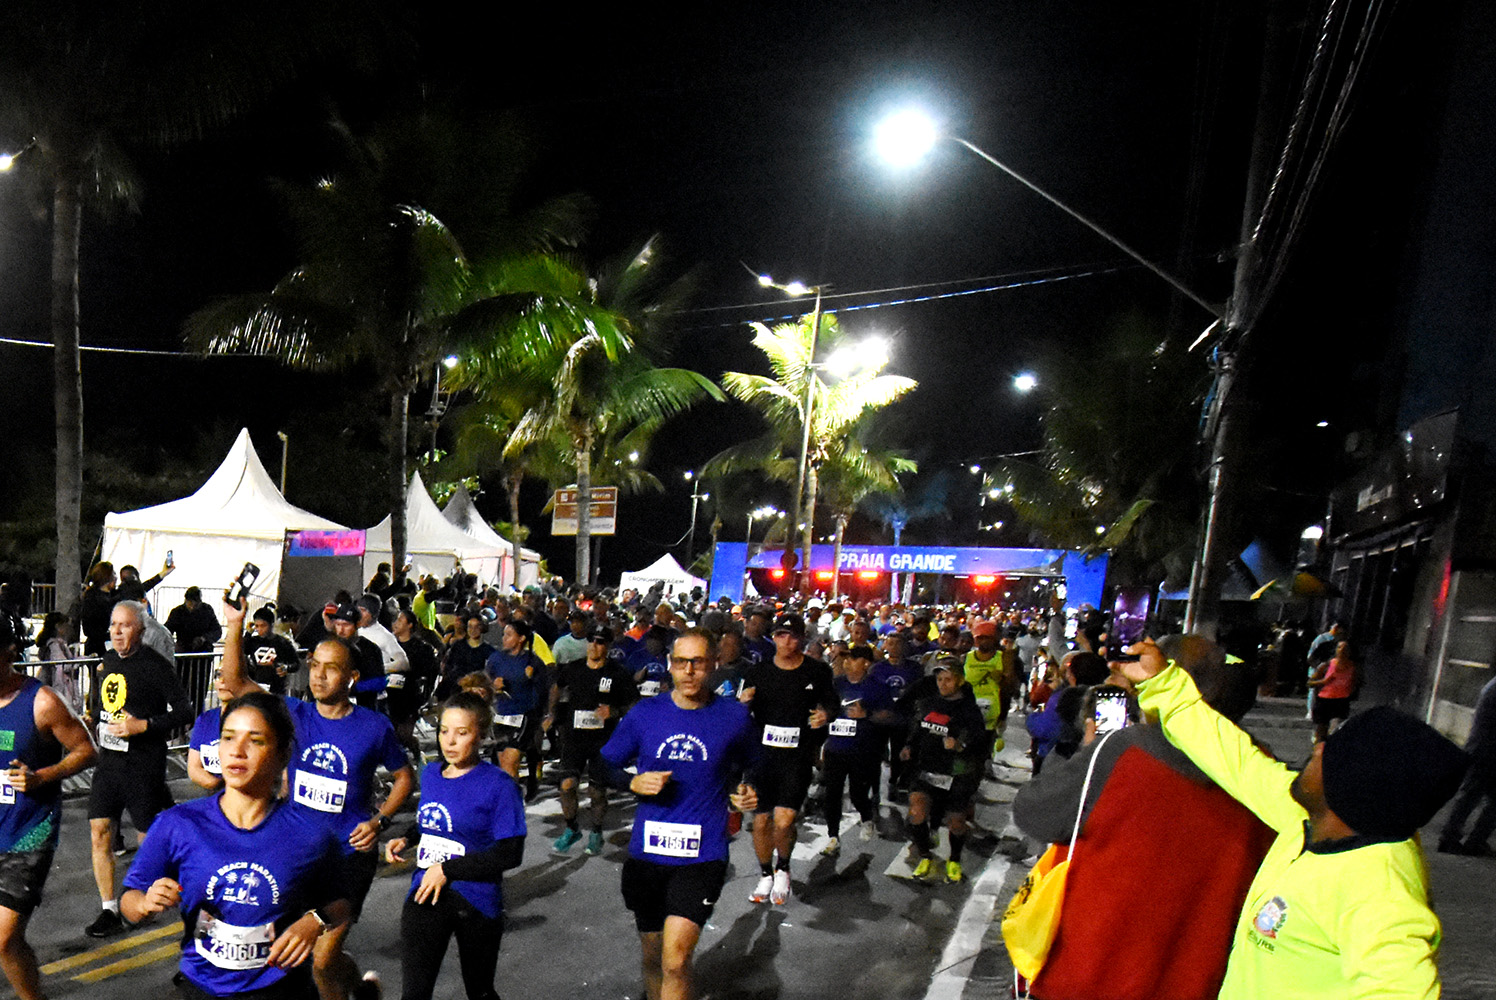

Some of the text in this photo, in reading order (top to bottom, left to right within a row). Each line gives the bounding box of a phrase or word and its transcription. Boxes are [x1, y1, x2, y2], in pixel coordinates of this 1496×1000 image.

[838, 552, 956, 571] PRAIA GRANDE
[206, 862, 280, 905] LONG BEACH MARATHON
[210, 938, 258, 961] 23060
